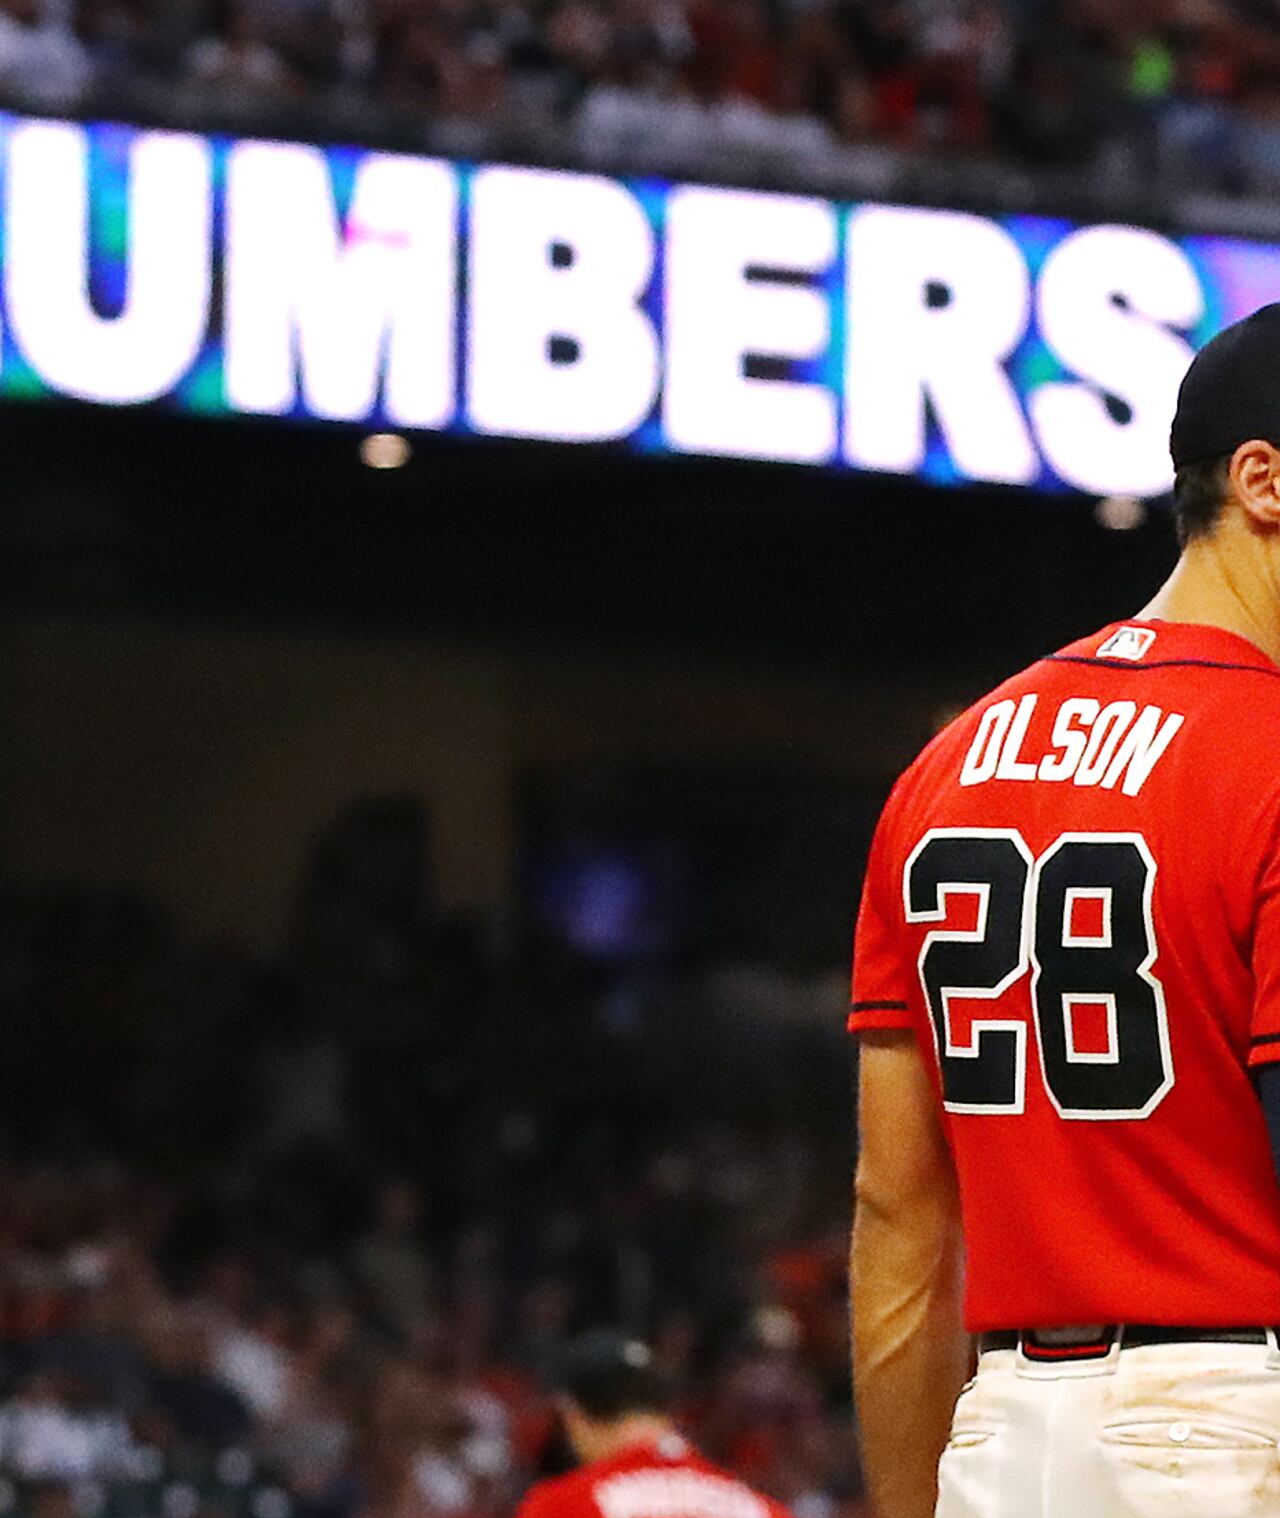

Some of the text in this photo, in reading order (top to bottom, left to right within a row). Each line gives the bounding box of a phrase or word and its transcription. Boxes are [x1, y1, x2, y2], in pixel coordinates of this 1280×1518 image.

[3, 116, 1205, 497] UMBERS
[959, 693, 1185, 797] OLSON
[902, 827, 1175, 1120] 28
